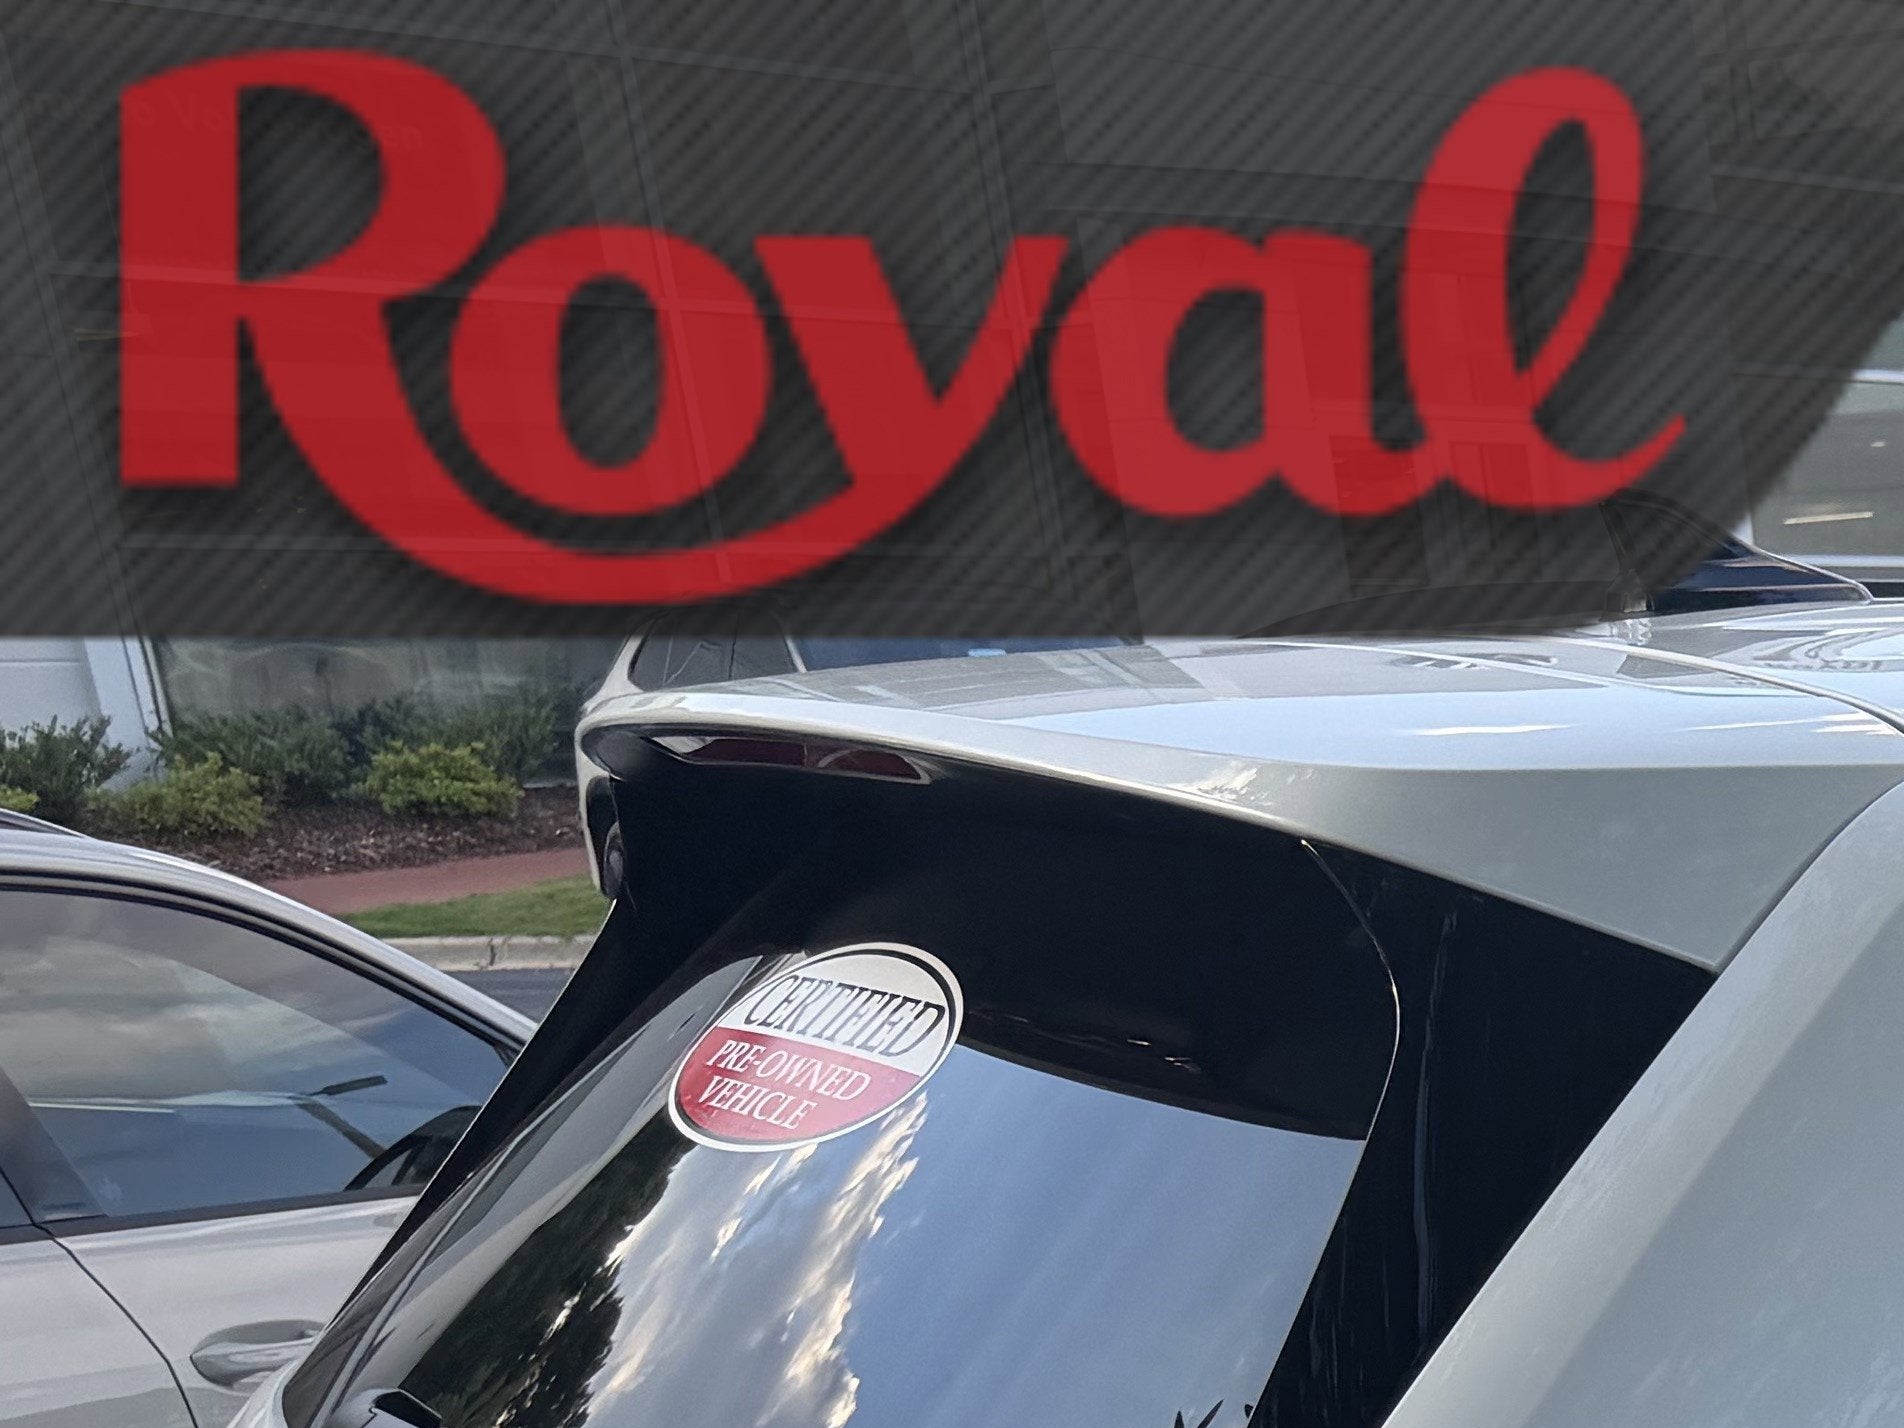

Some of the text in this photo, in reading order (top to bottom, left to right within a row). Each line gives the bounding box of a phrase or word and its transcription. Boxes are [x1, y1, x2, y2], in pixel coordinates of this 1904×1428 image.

[742, 974, 947, 1058] CERTIFIED
[698, 1075, 816, 1130] VEHICLE
[706, 1039, 871, 1103] PRE-OWNED
